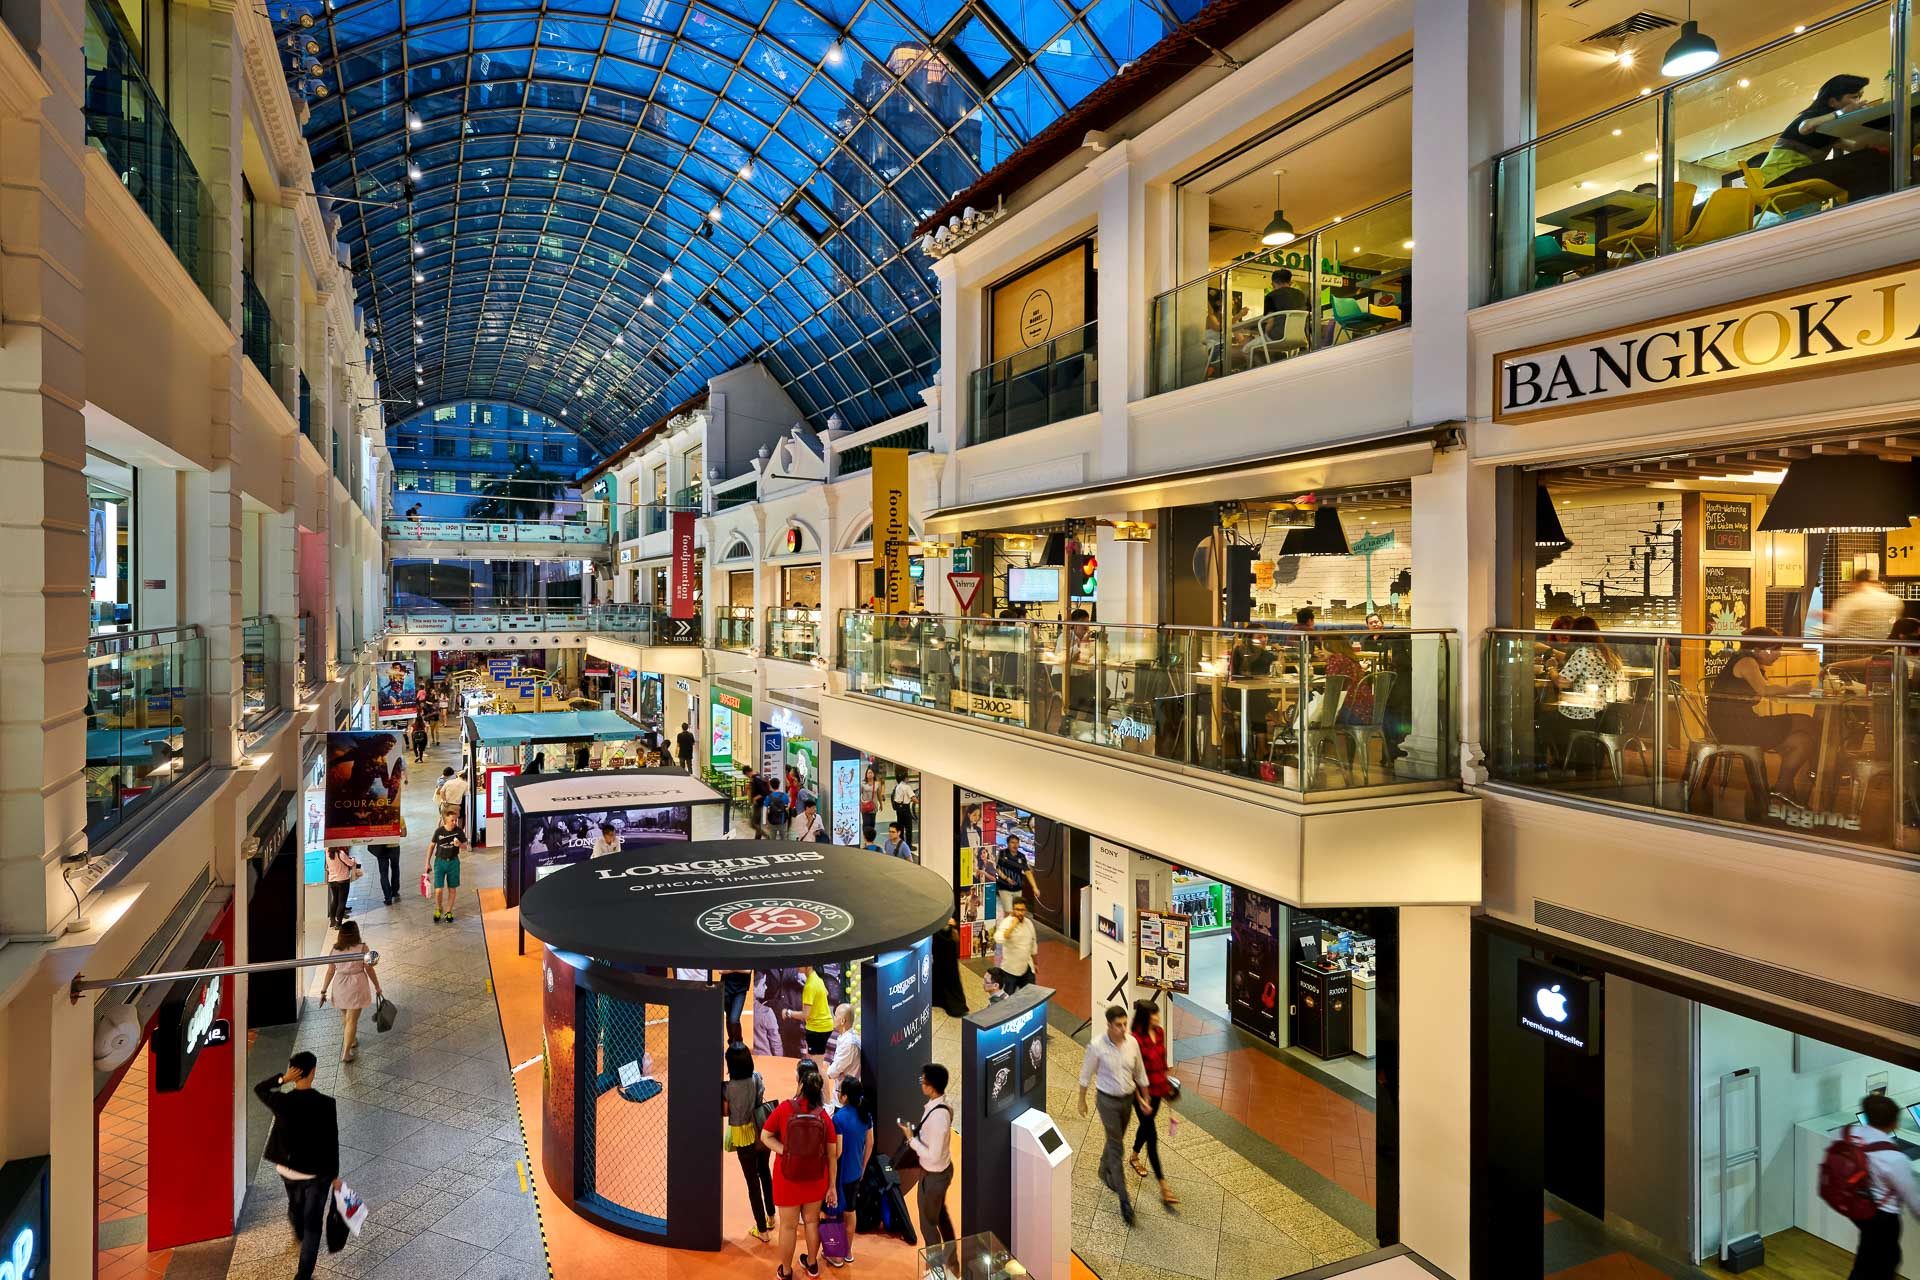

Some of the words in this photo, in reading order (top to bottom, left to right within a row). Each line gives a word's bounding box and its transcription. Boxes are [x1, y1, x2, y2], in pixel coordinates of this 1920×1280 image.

[1503, 294, 1853, 410] BANGKOK
[1706, 512, 1726, 524] BITES
[681, 535, 691, 600] foodjunction
[1705, 665, 1726, 676] BITE
[334, 797, 393, 810] COURAGE
[568, 835, 625, 848] LONGS
[1100, 846, 1119, 858] SONY
[595, 851, 826, 880] LONGINES
[629, 877, 714, 892] OFFICIAL
[714, 868, 825, 885] TIMEKEEPER
[704, 901, 754, 932] ROLAND
[762, 900, 843, 920] GARROS
[742, 927, 835, 942] PARIS
[1522, 1016, 1554, 1036] Premium
[1554, 1029, 1584, 1048] Reseller
